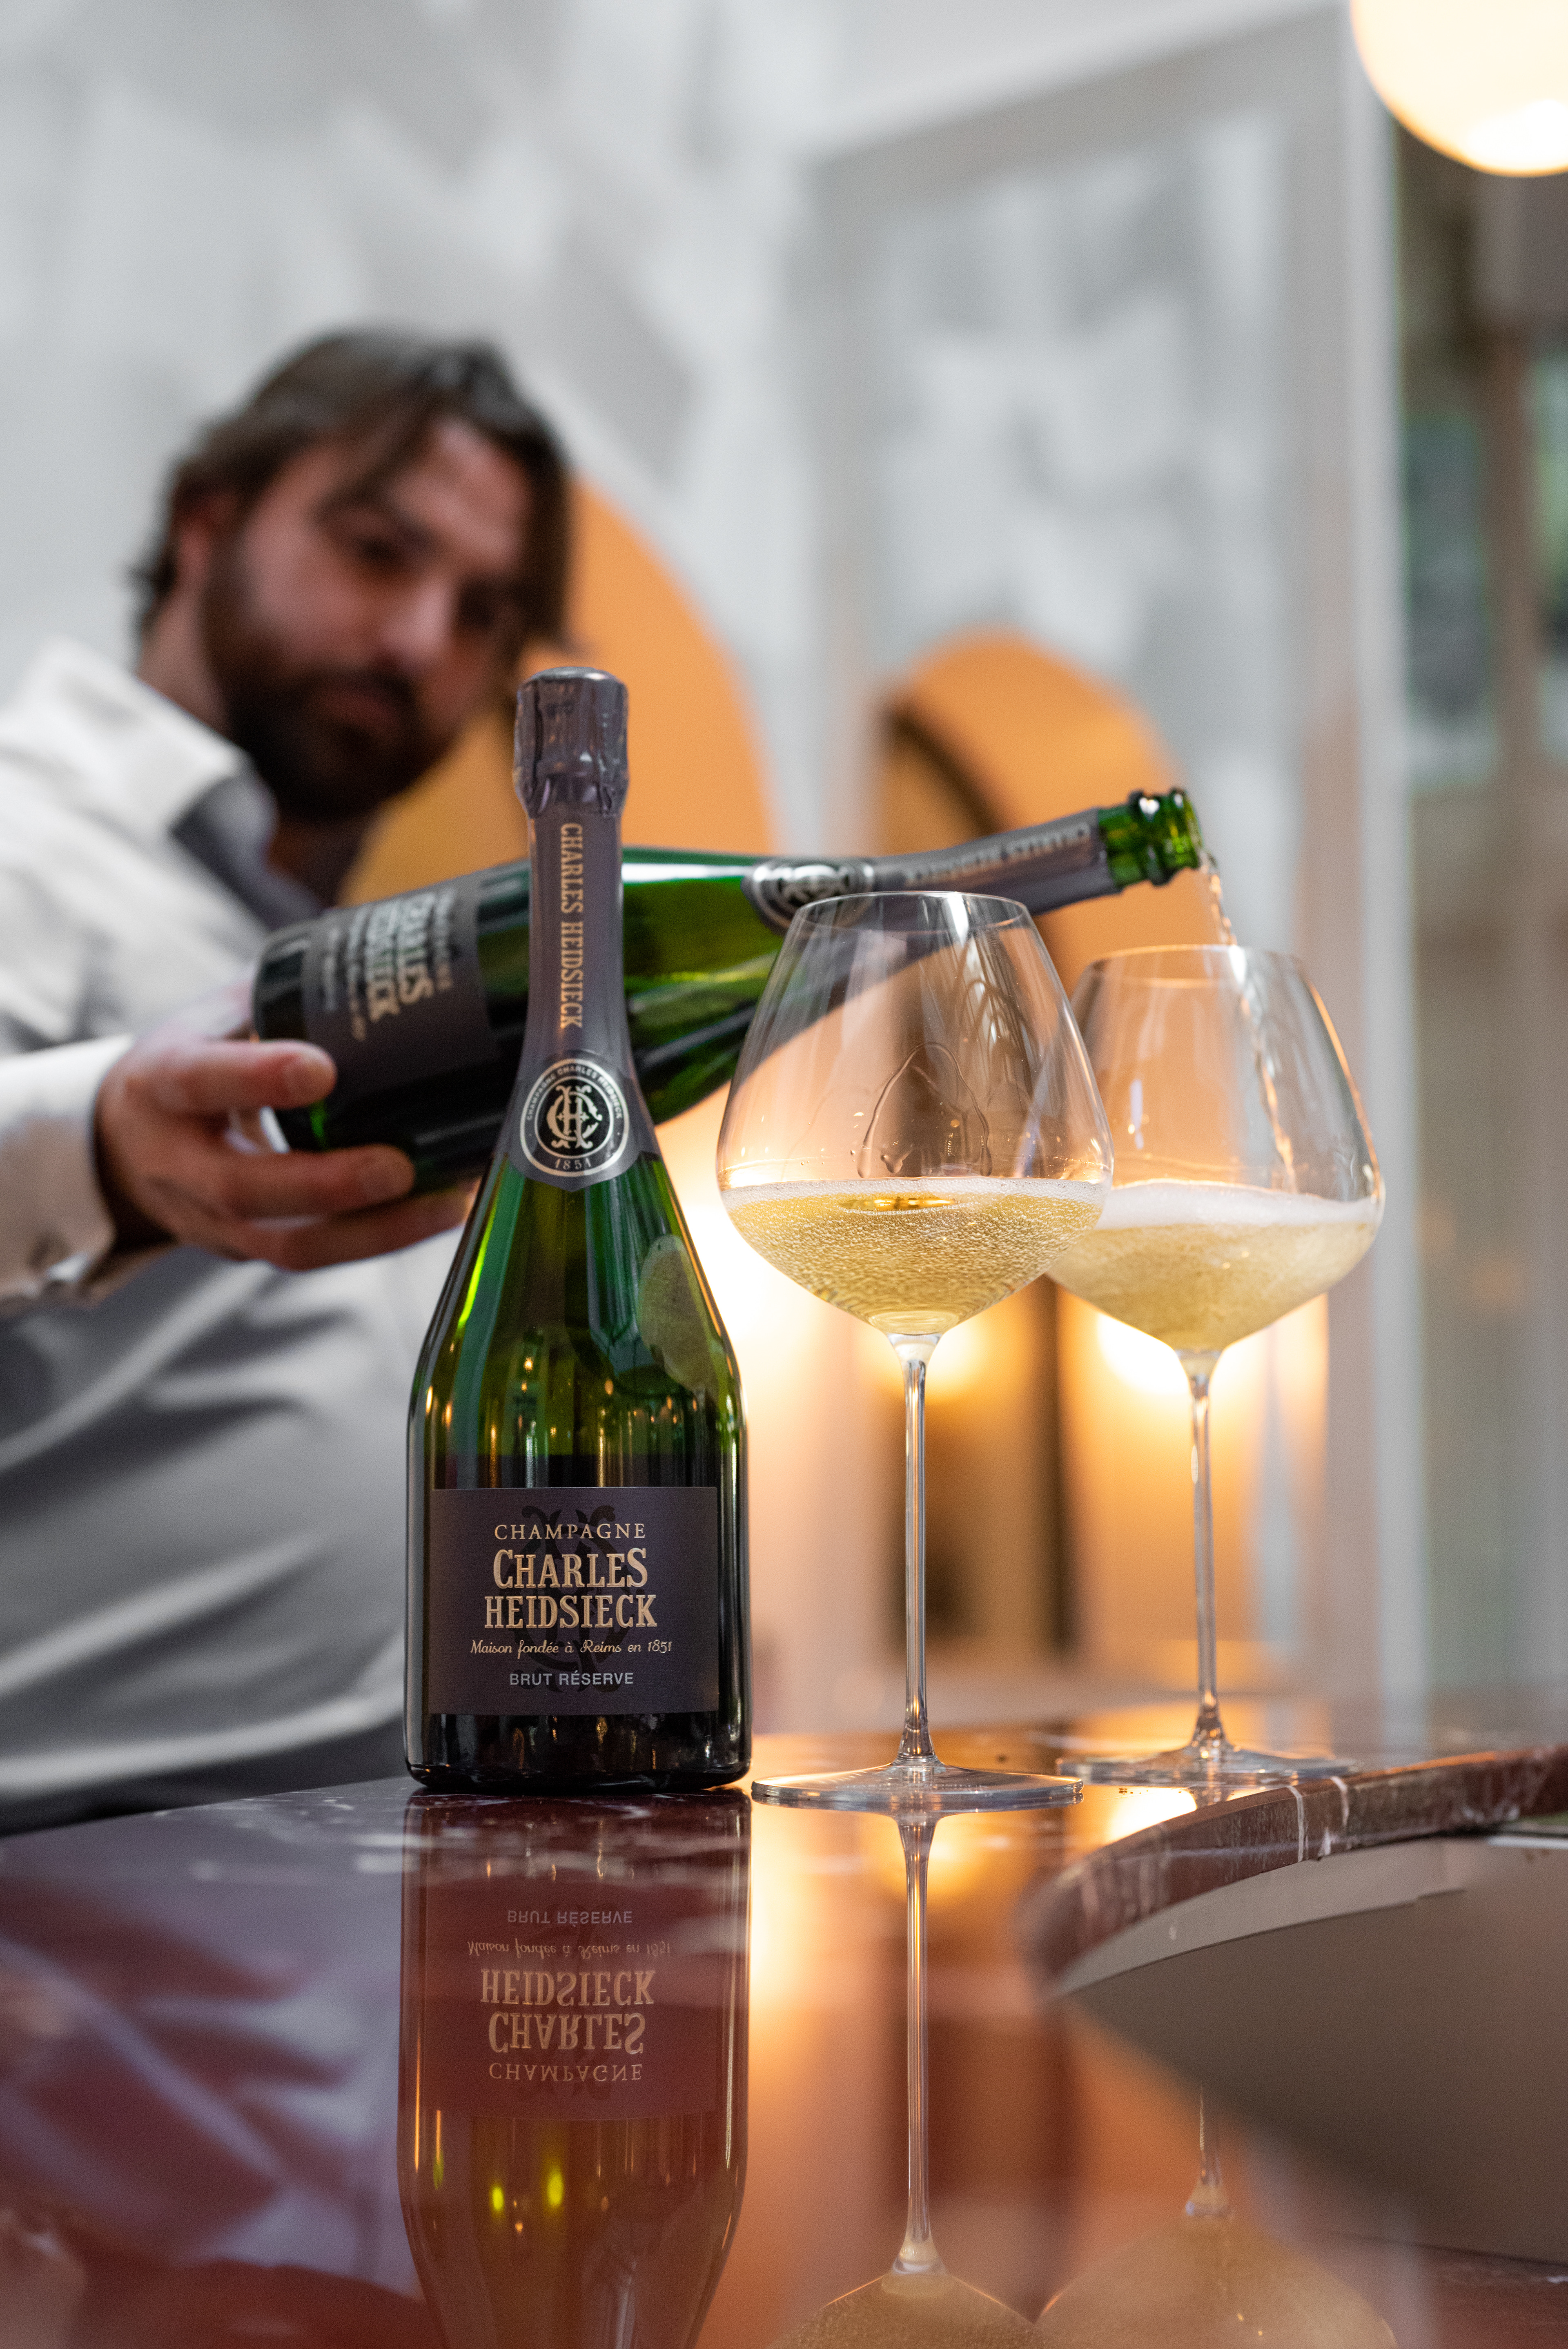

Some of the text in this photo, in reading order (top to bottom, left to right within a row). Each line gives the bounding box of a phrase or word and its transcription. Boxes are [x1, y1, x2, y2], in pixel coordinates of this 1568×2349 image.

[560, 823, 584, 1029] CHARLES HEIDSIECK
[555, 1157, 591, 1170] 1851
[494, 1523, 646, 1540] CHAMPAGNE
[493, 1547, 648, 1589] CHARLES
[484, 1594, 657, 1629] HEIDSIECK
[470, 1639, 672, 1659] Maison fondée à Reims en 1851
[510, 1669, 634, 1686] BRUT RÉSERVE
